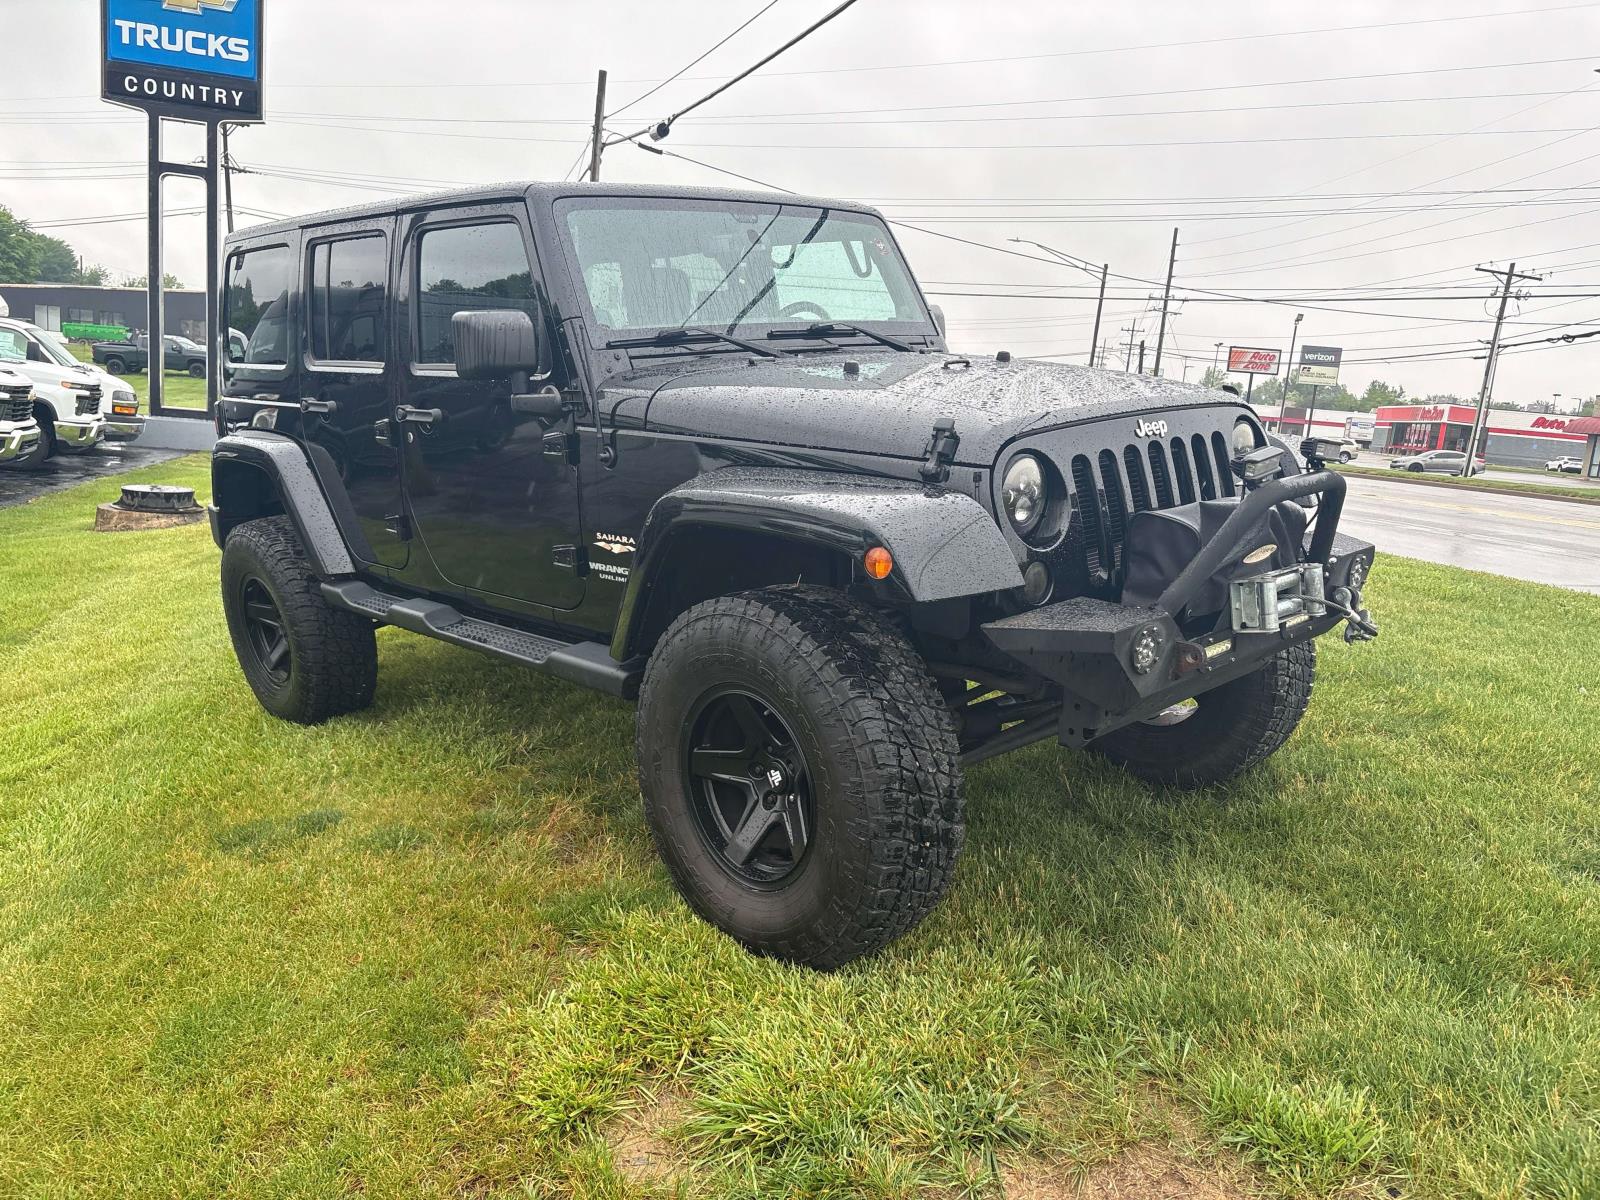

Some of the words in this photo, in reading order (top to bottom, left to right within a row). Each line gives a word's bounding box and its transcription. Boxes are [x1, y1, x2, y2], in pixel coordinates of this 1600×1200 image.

[114, 19, 250, 62] TRUCKS
[124, 75, 244, 107] COUNTRY
[1250, 351, 1276, 361] Auto
[1304, 352, 1335, 362] verizon
[1135, 419, 1168, 438] Jeep
[596, 532, 636, 545] SAHARA
